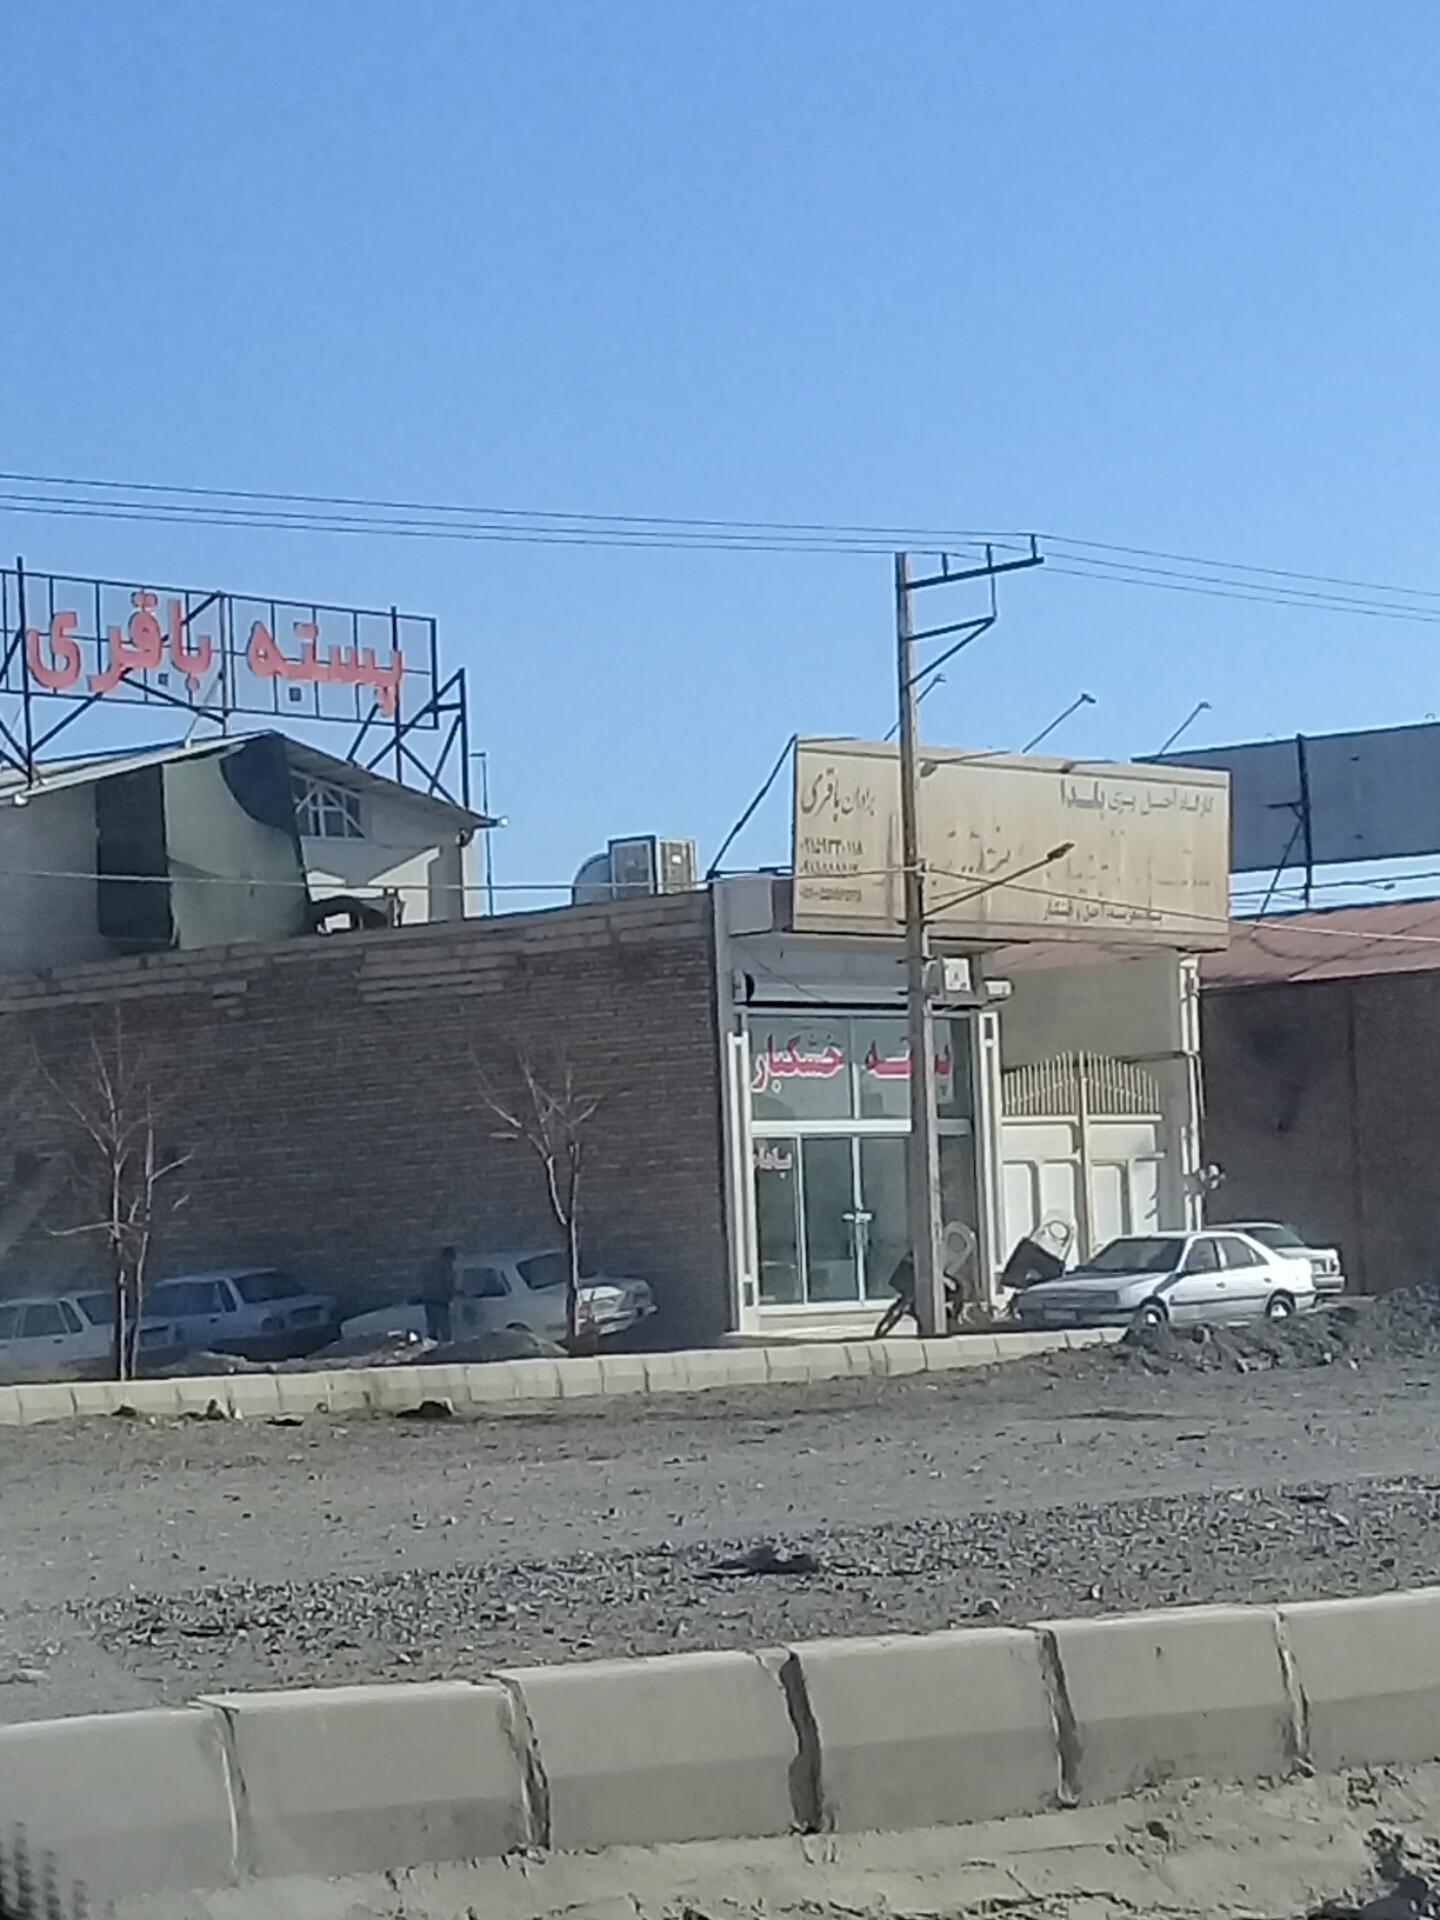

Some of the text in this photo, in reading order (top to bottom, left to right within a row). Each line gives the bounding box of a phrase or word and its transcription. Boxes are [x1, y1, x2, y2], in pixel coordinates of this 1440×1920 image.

[26, 588, 403, 717] پسته باقری
[801, 767, 840, 823] باقری
[750, 1032, 845, 1093] خشکبار
